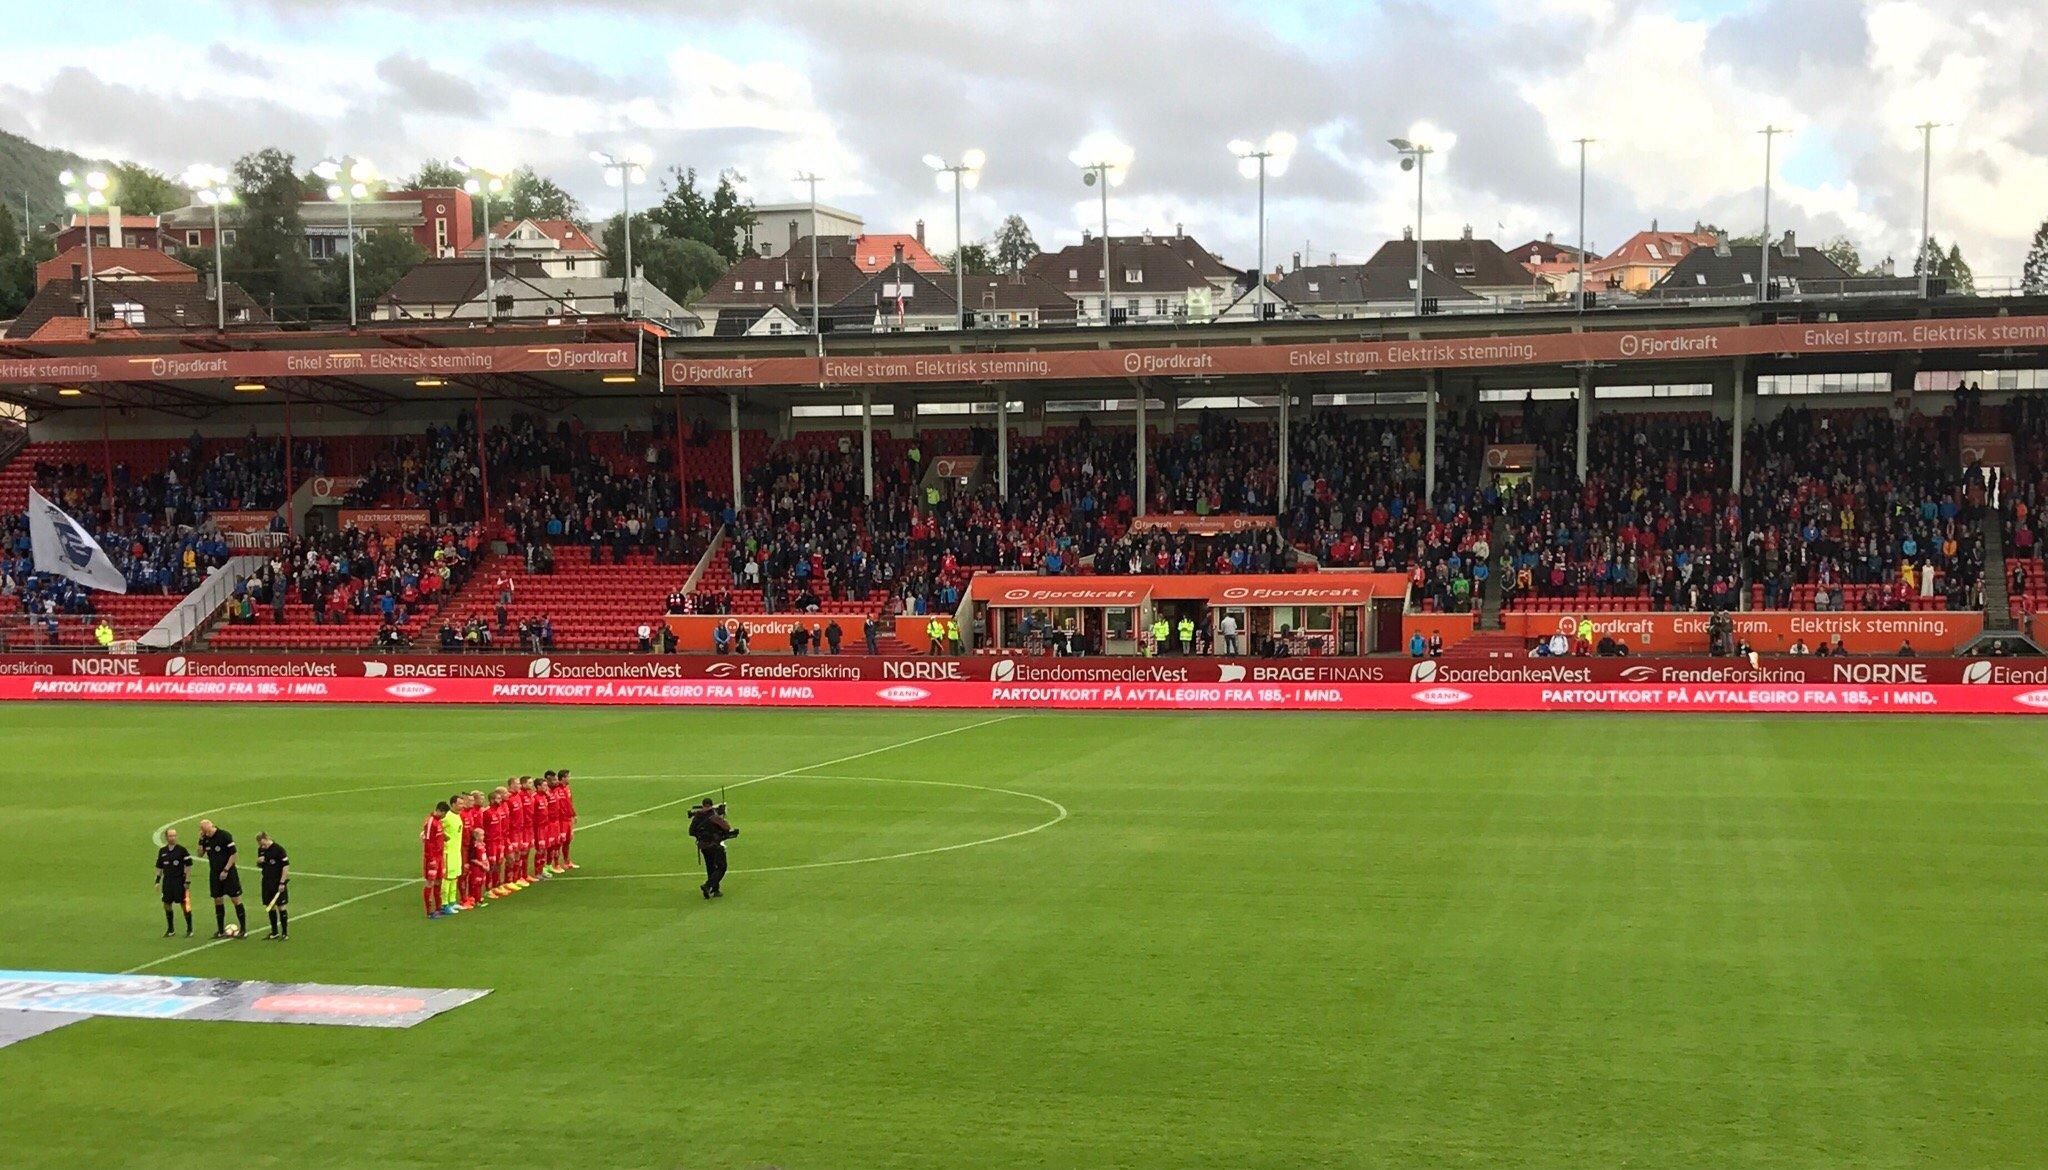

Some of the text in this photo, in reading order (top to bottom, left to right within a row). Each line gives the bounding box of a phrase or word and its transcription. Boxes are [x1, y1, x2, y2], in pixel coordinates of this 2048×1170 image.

[1641, 335, 1719, 352] Fjordkraft
[1804, 329, 1849, 345] Enkel
[1854, 327, 1908, 343] strøm.
[1912, 324, 1986, 342] Elektrisk
[287, 351, 493, 371] Enkel strøm. Elektrisk stemning
[564, 350, 628, 367] Fjordkraft
[1143, 354, 1213, 371] Fjordkraft
[1290, 343, 1538, 365] Enkel strøm. Elektrisk stemning.
[39, 361, 100, 379] stemning.
[167, 358, 228, 376] Fjordkraft
[689, 366, 754, 382] Fjordkraft
[826, 357, 1051, 378] Enkel strøm. Elektrisk stemning.
[1032, 588, 1137, 604] Fjordkraft
[1252, 587, 1360, 602] Fjordkraft
[743, 621, 801, 637] Fjordkra
[1592, 619, 1655, 634] ordkraft
[1673, 617, 1949, 637] Enke trøm. Elektrisk stemning.
[0, 661, 54, 675] orsikring
[72, 658, 141, 676] NORNE
[393, 663, 507, 678] BRAGE FINANS
[552, 662, 682, 679] SparebankenVest
[740, 662, 861, 681] FrendeForsikring
[882, 661, 962, 680] NORNE
[1253, 667, 1384, 682] BRAGE FINANS
[1661, 666, 1805, 684] FrendeForsikring
[1832, 663, 1927, 684] NORNE
[1994, 666, 2048, 684] Eiend
[32, 682, 124, 694] PARTOUTKORT
[126, 679, 143, 694] PÅ
[144, 682, 227, 694] AVTALEGIRO
[228, 682, 253, 695] FRA
[256, 682, 285, 696] 185,-
[295, 683, 328, 695] MND.
[492, 684, 592, 697] PARTOUTKORT
[595, 682, 614, 697] PÅ
[617, 685, 703, 698] AVTALEGIRO
[706, 685, 734, 698] FRA
[737, 685, 769, 699] 185,-
[779, 686, 815, 699] MND.
[992, 688, 1100, 701] PARTOUTKORT
[1104, 685, 1124, 701] PÅ
[1127, 688, 1220, 702] AVTALEGIRO
[1224, 688, 1254, 702] FRA
[1258, 689, 1291, 704] 185,-
[1304, 690, 1343, 703] MND.
[1541, 690, 1662, 704] PARTOUTKORT
[1668, 687, 1690, 704] PÅ
[1693, 690, 1800, 704] AVTALEGIRO
[1803, 690, 1835, 704] FRA
[1841, 690, 1879, 706] 185,-
[1894, 691, 1937, 705] MND.
